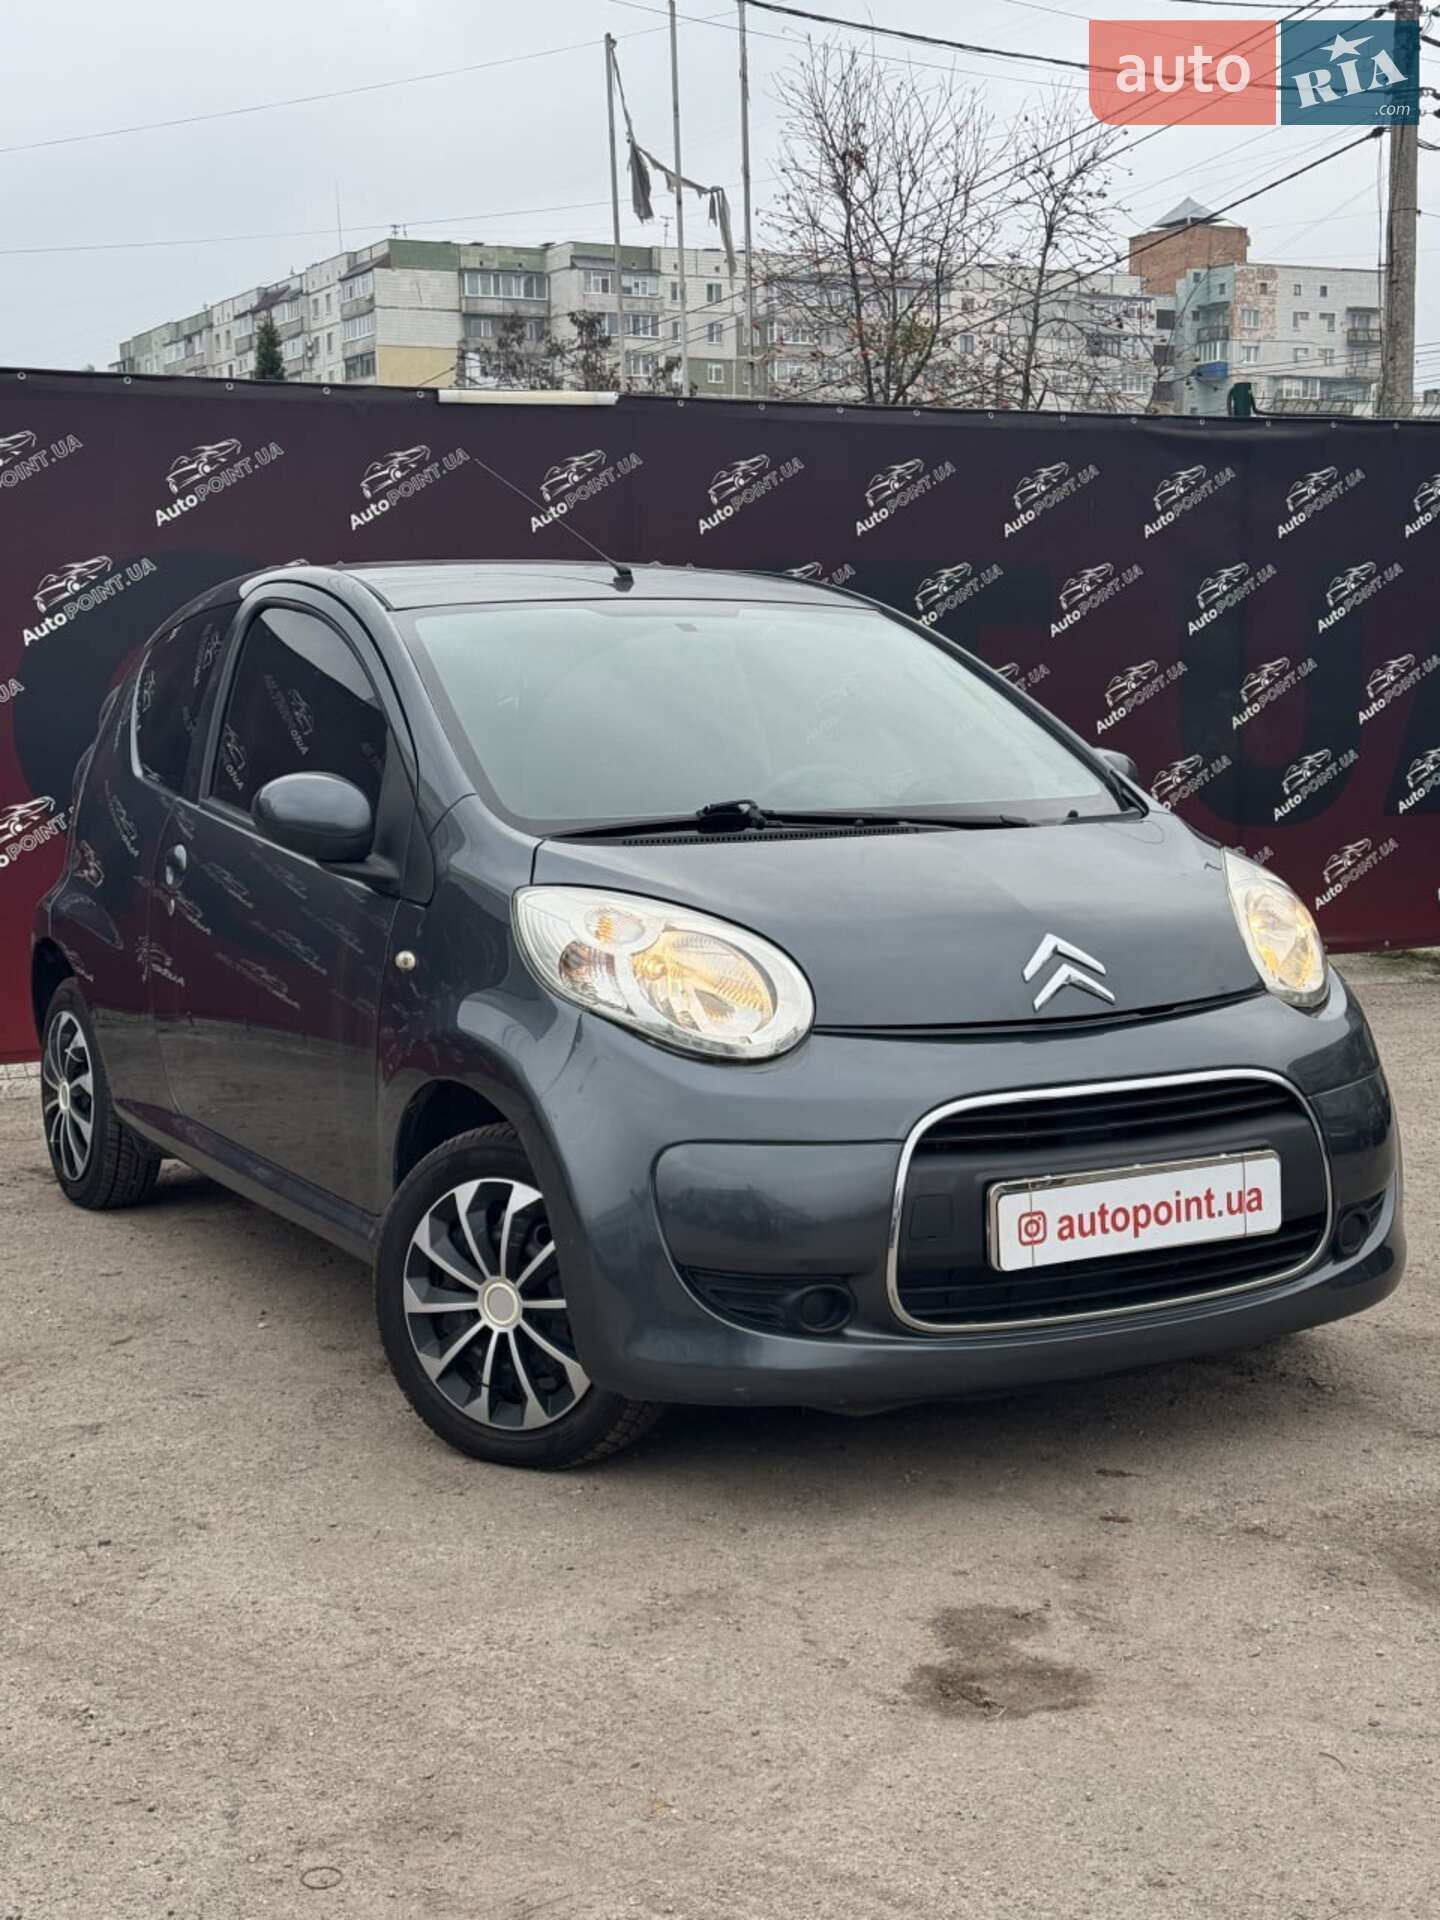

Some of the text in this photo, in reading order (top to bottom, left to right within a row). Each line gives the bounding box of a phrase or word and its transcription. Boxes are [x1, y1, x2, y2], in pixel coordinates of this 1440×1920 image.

[0, 434, 83, 489] OINT.UA
[155, 442, 285, 527] AutoPOINT.UA
[349, 447, 471, 531] AutoPOINT.UA
[529, 452, 643, 533] AutoPOINT.UA
[698, 456, 804, 535] AutoPOINT.UA
[855, 460, 956, 537] AutoPOINT.UA
[1003, 464, 1100, 538] AutoPOINT.UA
[1143, 466, 1237, 539] AutoPOINT.UA
[1277, 467, 1366, 540] AutoPOINT.UA
[22, 557, 157, 648] AutoPOINT.UA
[918, 563, 1004, 627] toPOINT.UA
[1050, 564, 1144, 638] AutoPOINT.UA
[1187, 563, 1278, 636] AutoPOINT.UA
[1317, 562, 1405, 634] AutoPOINT.UA
[1096, 660, 1188, 735] AutoPOINT.UA
[1231, 657, 1318, 731] AutoPOINT.UA
[1273, 748, 1359, 822] AutoPOINT.UA
[1314, 838, 1399, 911] AutoPOINT.UA
[1057, 1187, 1264, 1240] autopoint.ua
